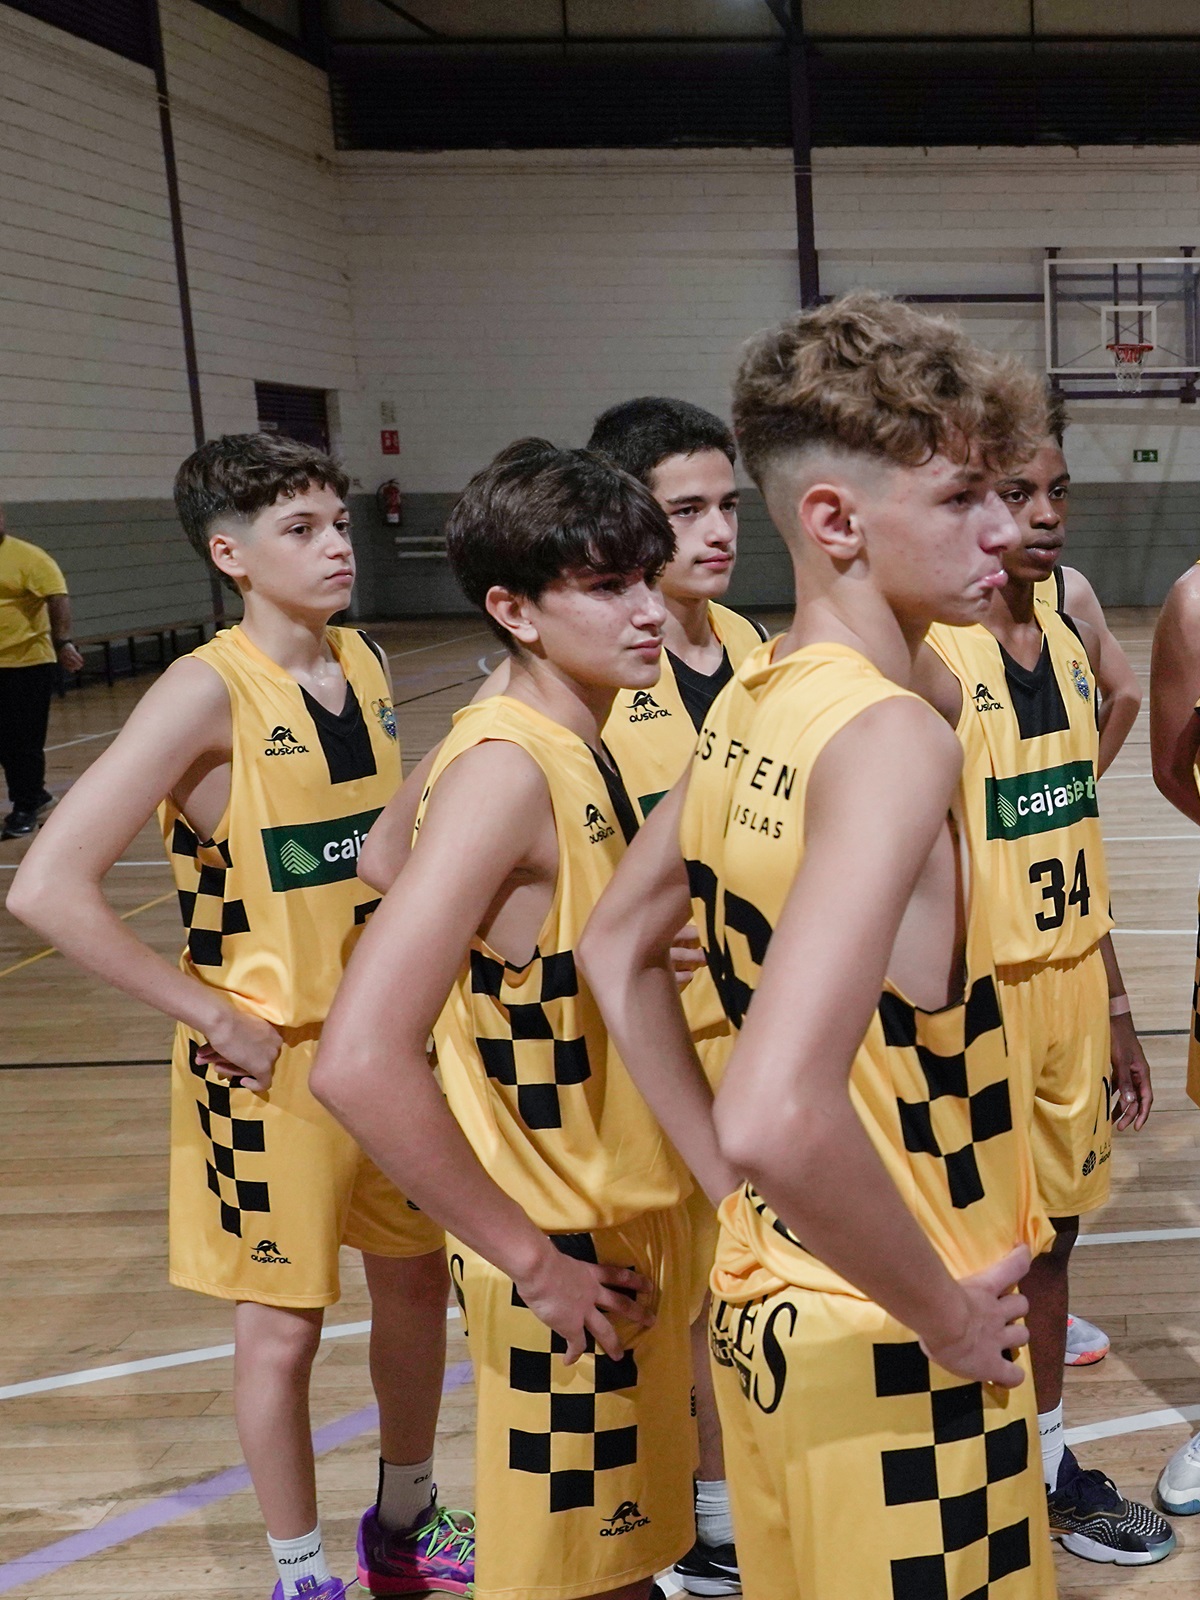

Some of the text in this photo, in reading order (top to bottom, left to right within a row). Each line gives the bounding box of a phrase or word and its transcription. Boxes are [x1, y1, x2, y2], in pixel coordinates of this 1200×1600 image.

[629, 709, 672, 723] austral
[264, 745, 310, 757] austral
[1028, 847, 1091, 932] 34
[250, 1254, 292, 1265] austral
[599, 1516, 652, 1537] austral
